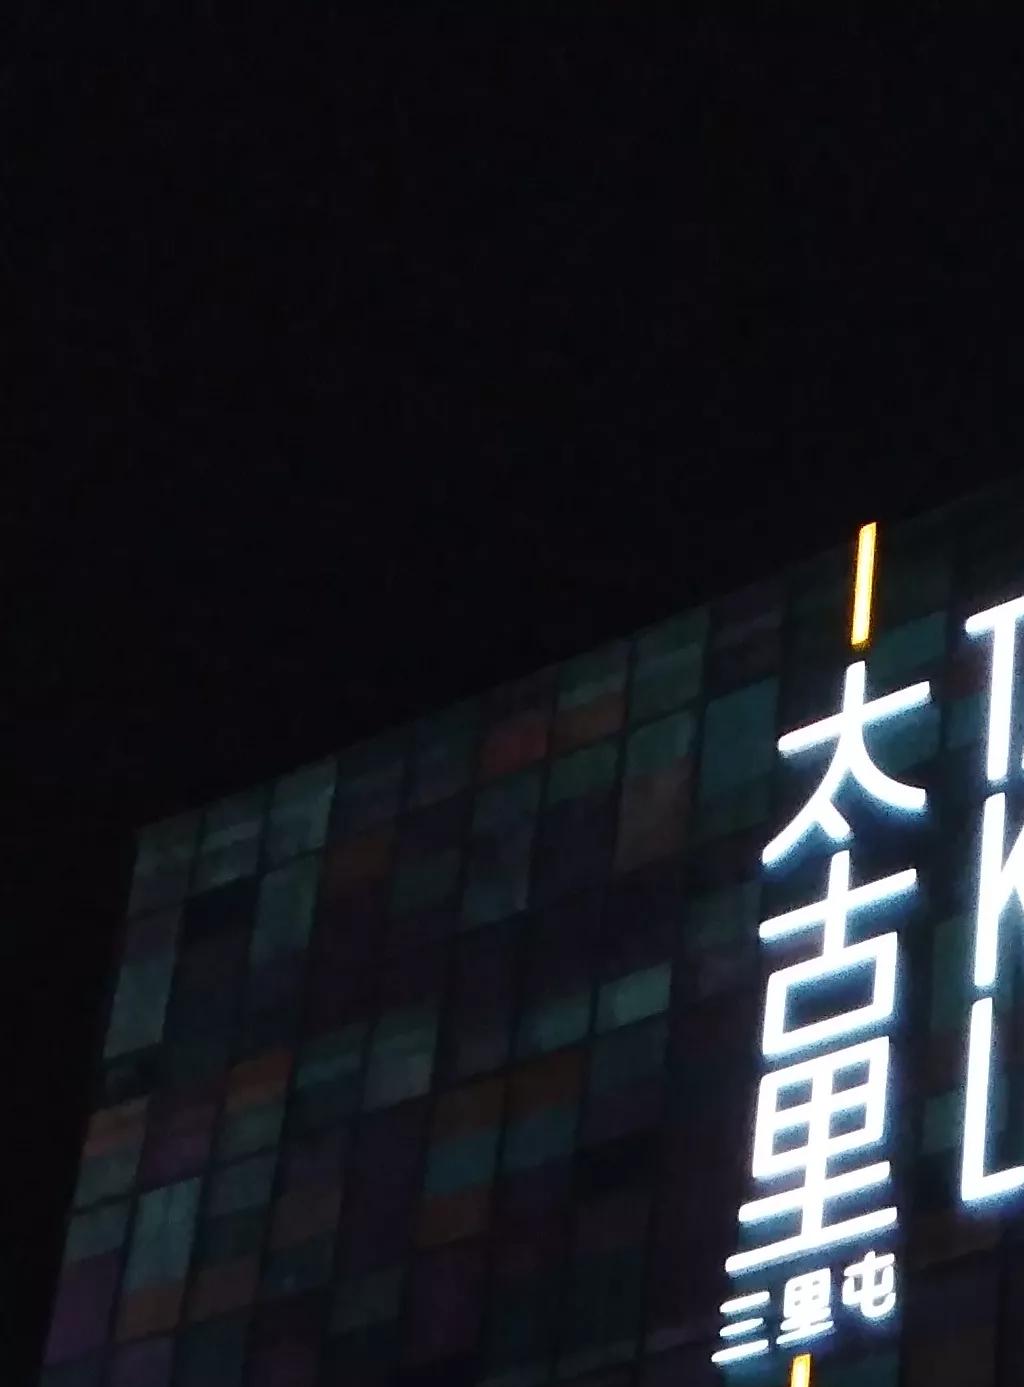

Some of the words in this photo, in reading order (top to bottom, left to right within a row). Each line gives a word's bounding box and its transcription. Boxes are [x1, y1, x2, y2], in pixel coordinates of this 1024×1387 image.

[726, 660, 930, 1273] 太古里
[711, 1250, 898, 1363] 三里屯
